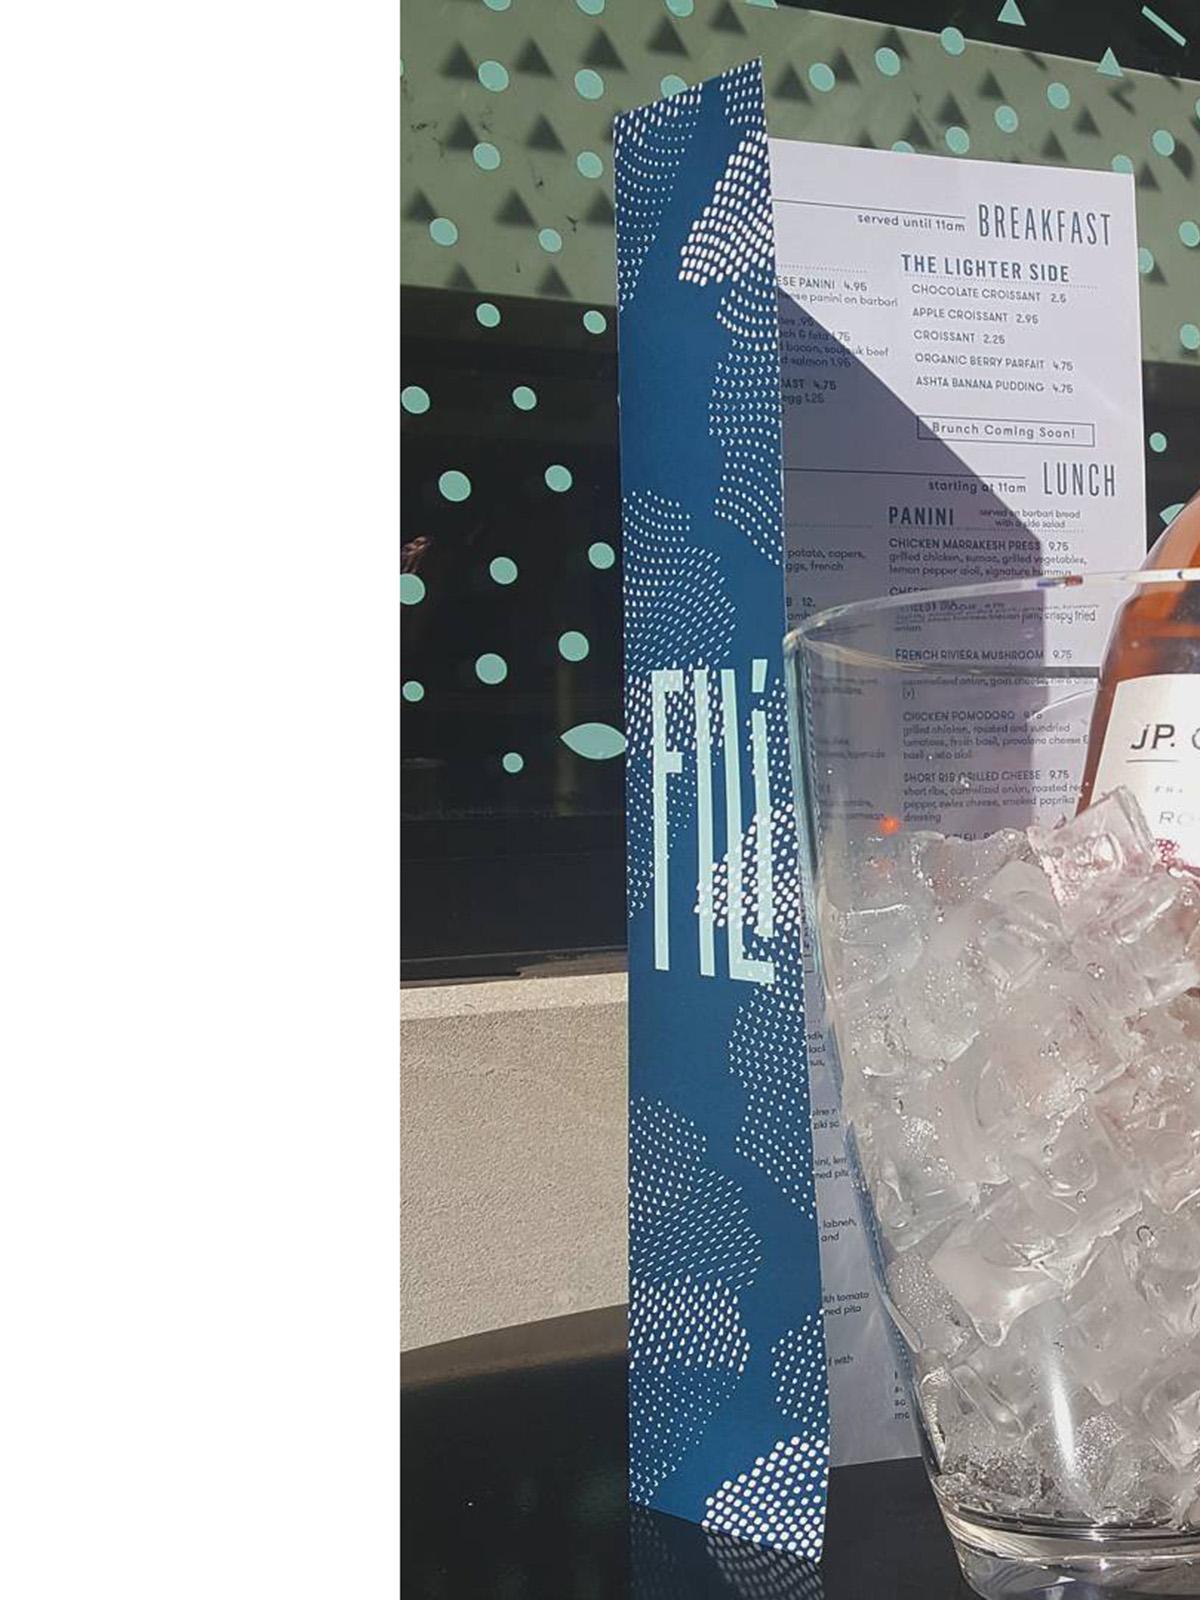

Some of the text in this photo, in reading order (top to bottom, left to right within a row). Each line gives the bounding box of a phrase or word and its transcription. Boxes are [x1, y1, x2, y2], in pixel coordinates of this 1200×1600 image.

[858, 203, 1112, 246] served until 11am BREAKFAST
[901, 254, 1070, 283] THE LIGHTER SIDE
[799, 277, 836, 290] PANINI
[843, 280, 868, 292] 4.95
[810, 293, 842, 305] panini
[844, 297, 857, 305] on
[860, 295, 898, 307] barbari
[911, 284, 1067, 303] CHOCOLATE CROISSANT 2.5
[912, 308, 1039, 324] APPLE CROISSANT 2.95
[913, 330, 1005, 345] CROISSANT 2.25
[915, 353, 1073, 371] ORGANIC BERRY PARFAIT 4.75
[916, 376, 1073, 394] ASHTA BANANA PUDDING 4.75
[932, 422, 1076, 440] Brunch Coming Soon!
[928, 461, 1116, 497] starting at 11am LUNCH
[888, 505, 954, 526] PANINI
[888, 537, 1069, 552] CHICKEN MARRAKESH PRESS 9.75
[889, 552, 919, 564] grilled
[922, 553, 964, 564] chicken,
[1002, 553, 1032, 566] grilled
[1075, 610, 1096, 621] fried
[895, 650, 1073, 661] FRENCH RIVIERA MUSHROOM 9.75
[903, 711, 949, 721] CHICKEN
[952, 711, 1016, 721] POMODORO
[904, 772, 936, 783] SHORT
[1001, 770, 1041, 780] CHEESE
[1050, 770, 1069, 780] 9.75
[821, 1232, 839, 1243] and
[837, 1291, 869, 1303] tomato
[844, 1304, 862, 1316] pita
